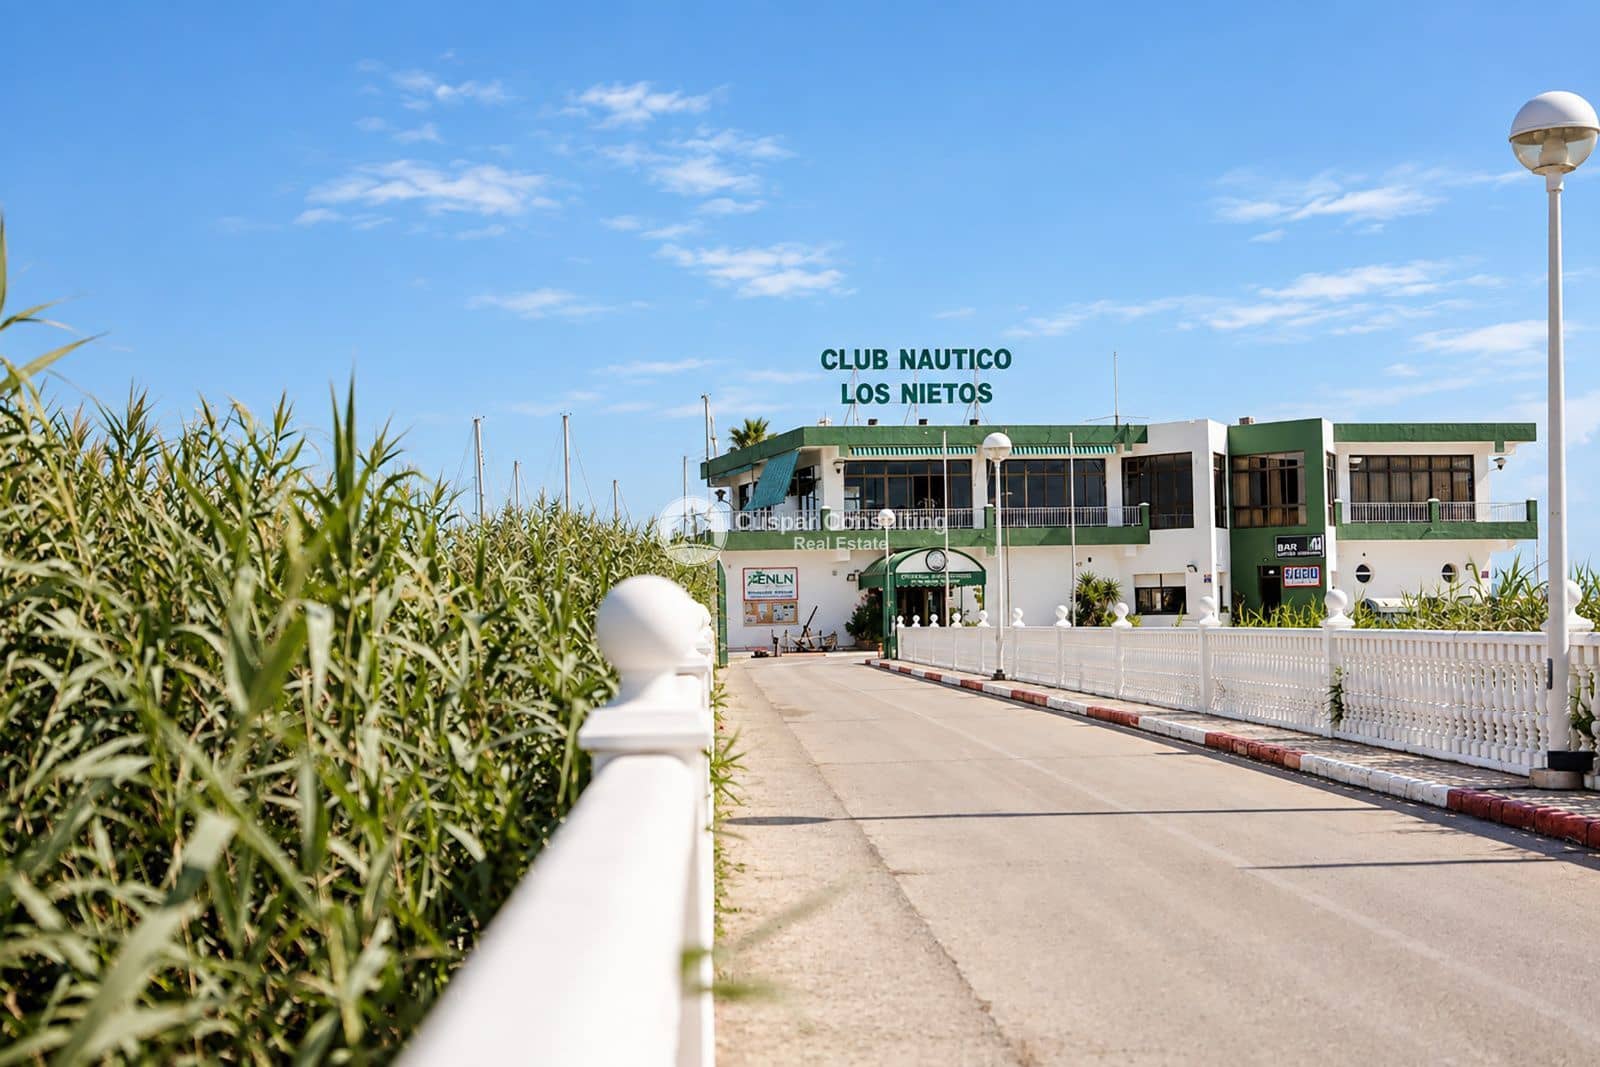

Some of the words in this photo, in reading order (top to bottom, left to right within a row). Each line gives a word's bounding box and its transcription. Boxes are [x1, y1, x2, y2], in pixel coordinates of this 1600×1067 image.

[821, 349, 888, 370] CLUB
[900, 349, 1012, 370] NAUTICO
[841, 383, 890, 404] LOS
[901, 383, 993, 404] NIETOS
[1277, 543, 1298, 552] BAR
